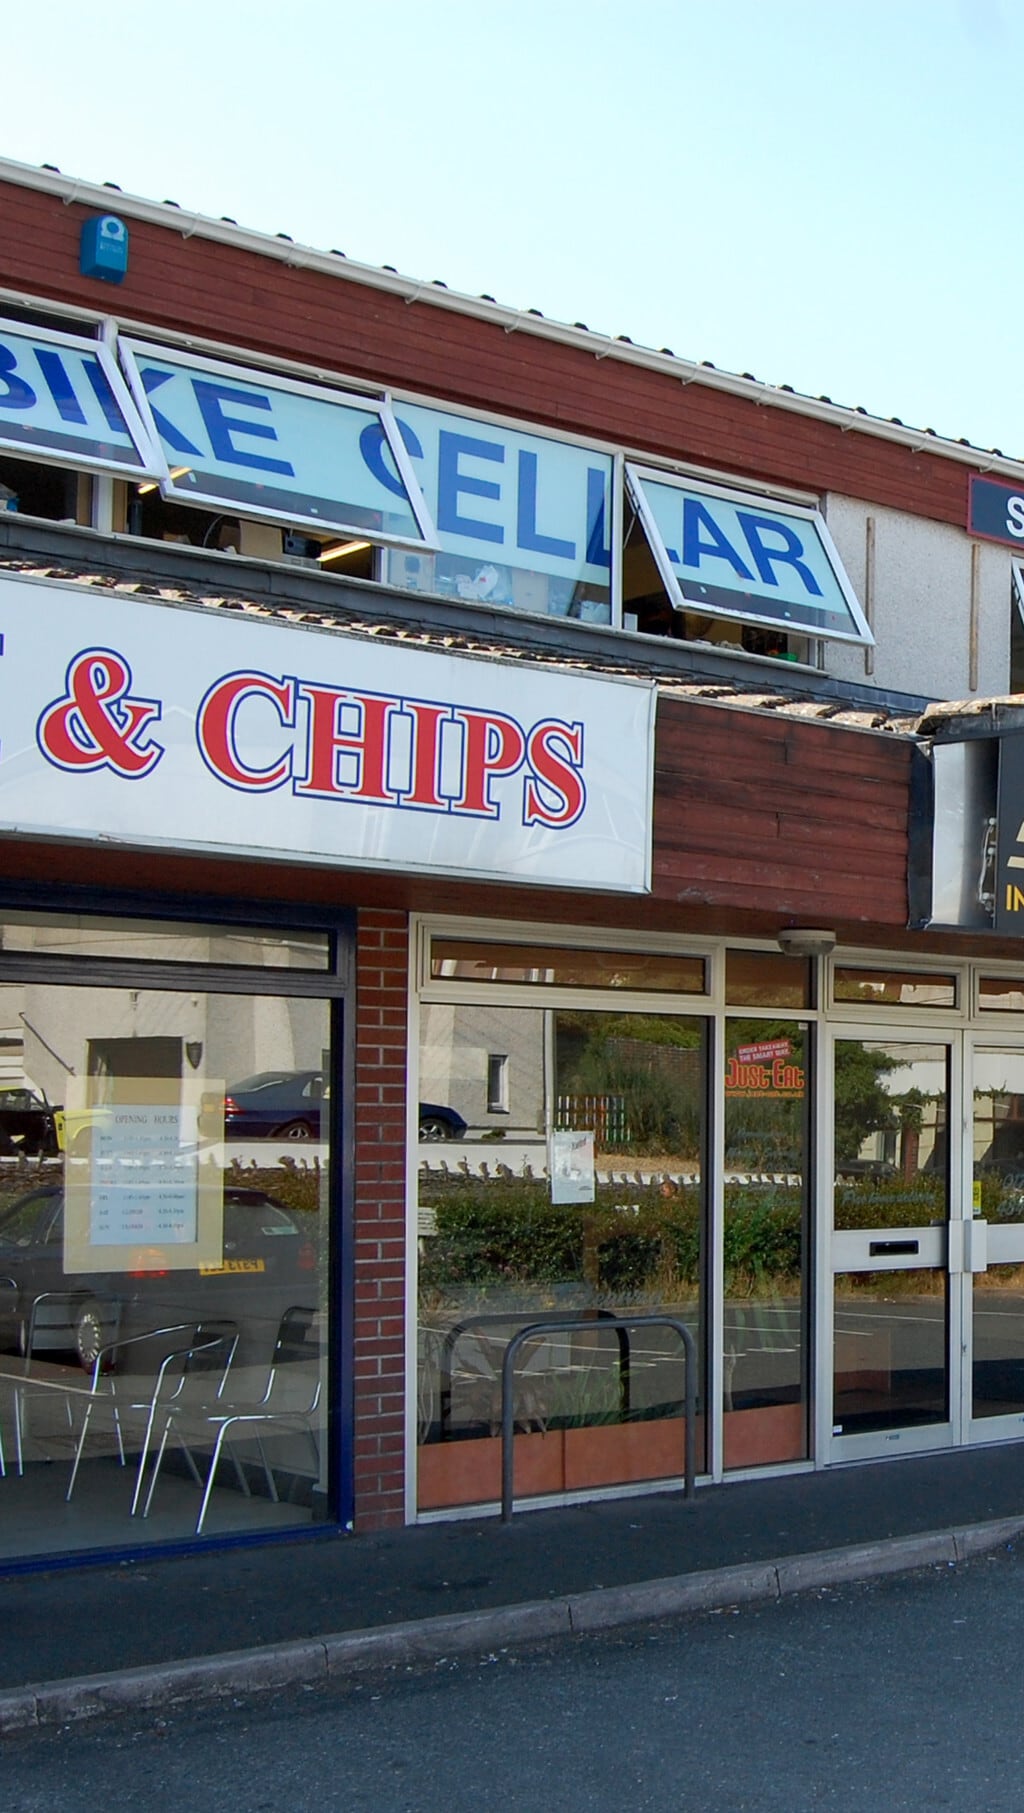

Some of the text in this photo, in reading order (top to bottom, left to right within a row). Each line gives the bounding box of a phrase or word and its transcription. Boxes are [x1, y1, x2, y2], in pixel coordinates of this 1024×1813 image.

[36, 646, 587, 829] & CHIPS
[115, 1115, 179, 1125] OPENING HOURS
